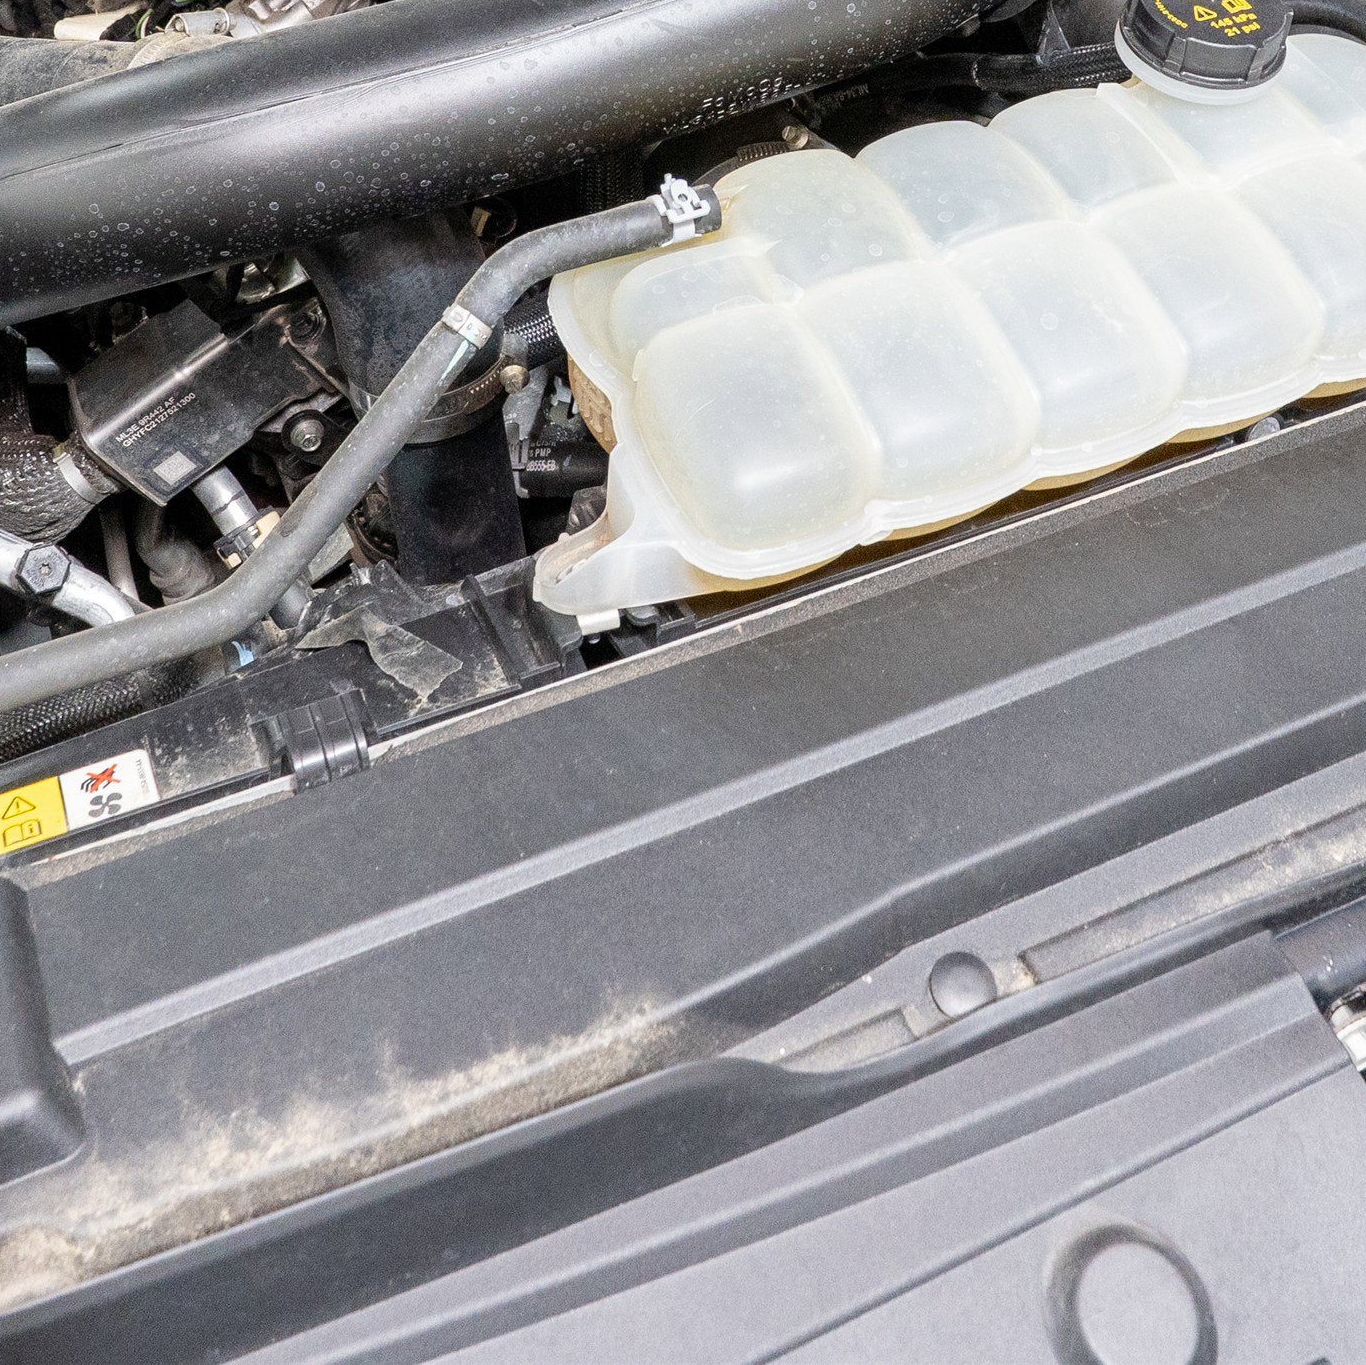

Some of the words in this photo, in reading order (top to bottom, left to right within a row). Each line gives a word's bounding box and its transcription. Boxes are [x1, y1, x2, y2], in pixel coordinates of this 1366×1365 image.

[1232, 13, 1257, 24] kPa
[1224, 27, 1241, 36] 21
[1241, 21, 1261, 34] psi
[115, 424, 140, 443] ML3E
[164, 396, 176, 409] AF
